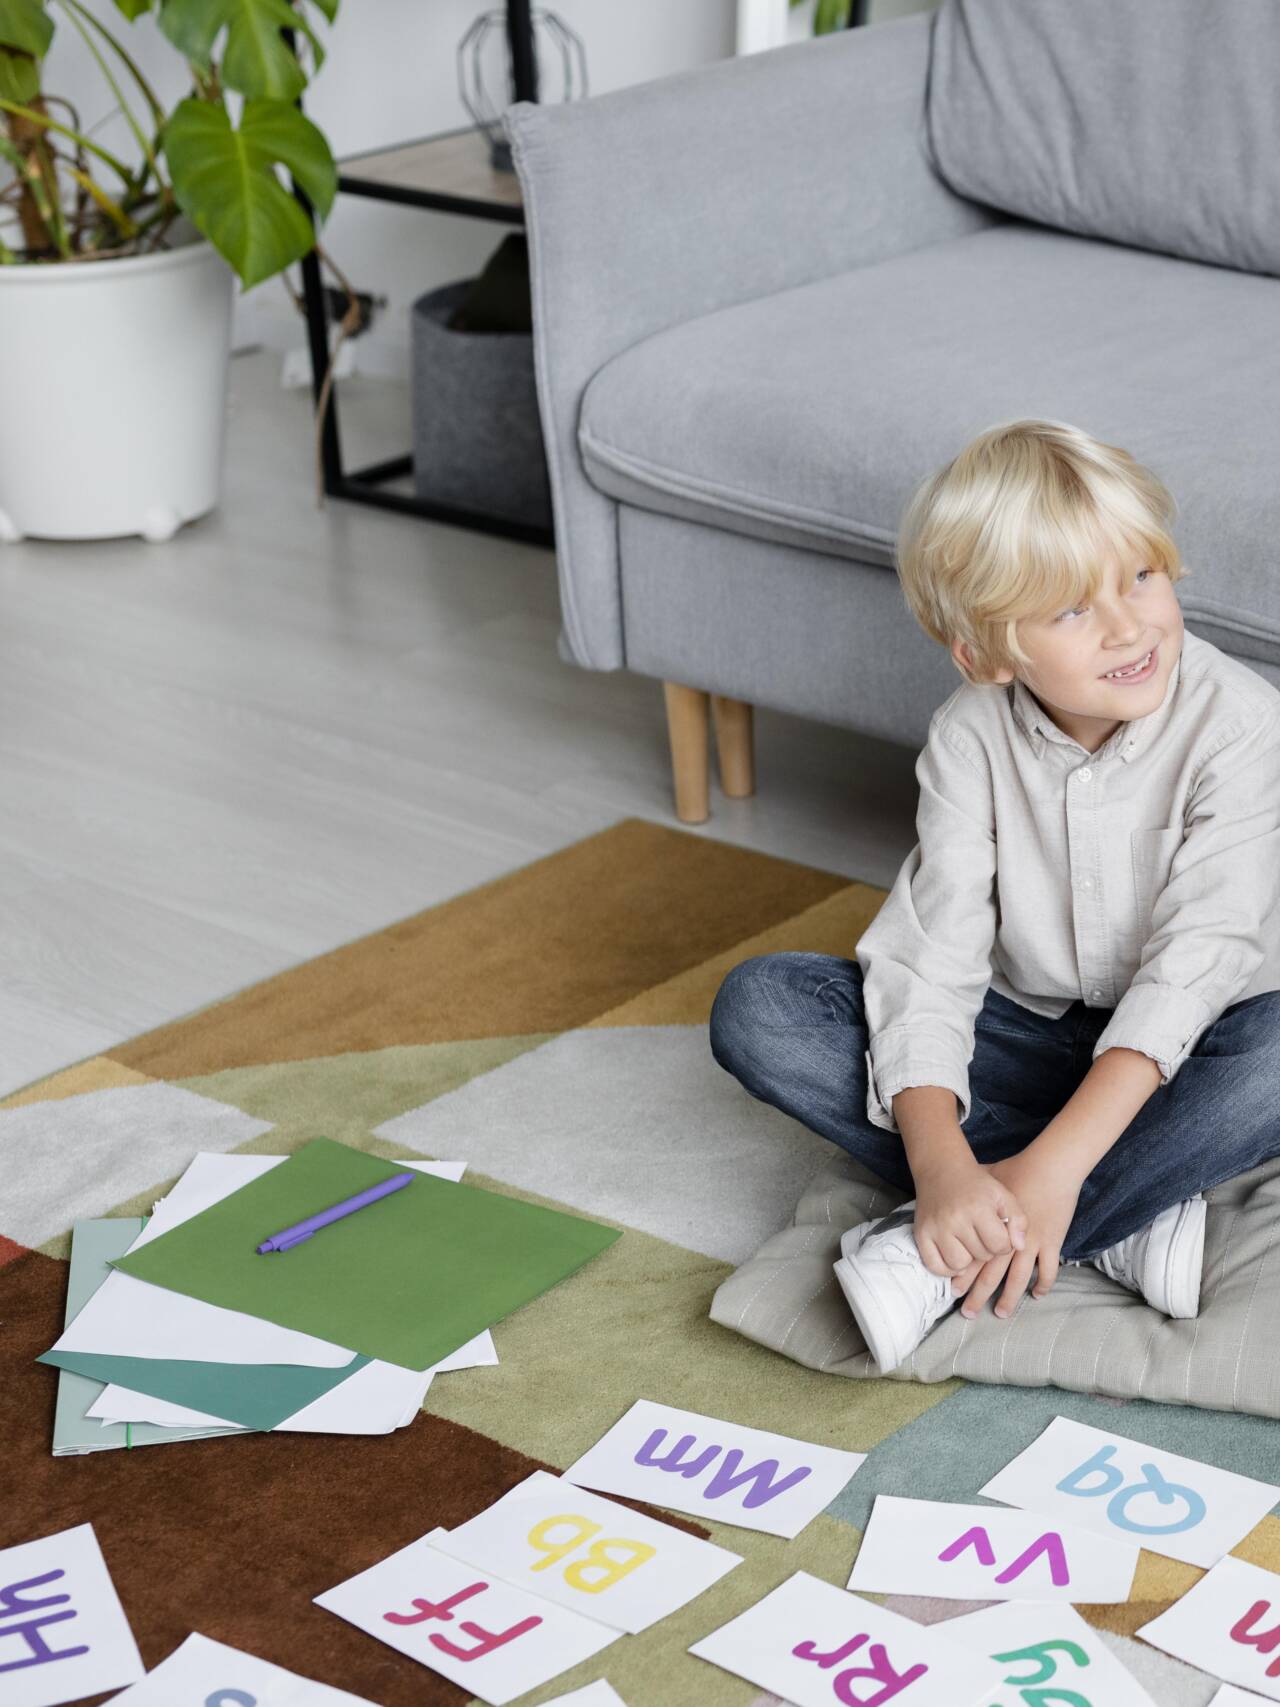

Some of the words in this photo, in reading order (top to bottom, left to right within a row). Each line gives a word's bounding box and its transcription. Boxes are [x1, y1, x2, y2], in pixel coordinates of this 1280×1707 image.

[634, 1427, 811, 1509] Mm
[1058, 1445, 1205, 1535] Qq
[527, 1514, 657, 1595] Bb
[938, 1526, 1071, 1587] Vv
[383, 1581, 543, 1663] Ff
[792, 1633, 929, 1707] Rr
